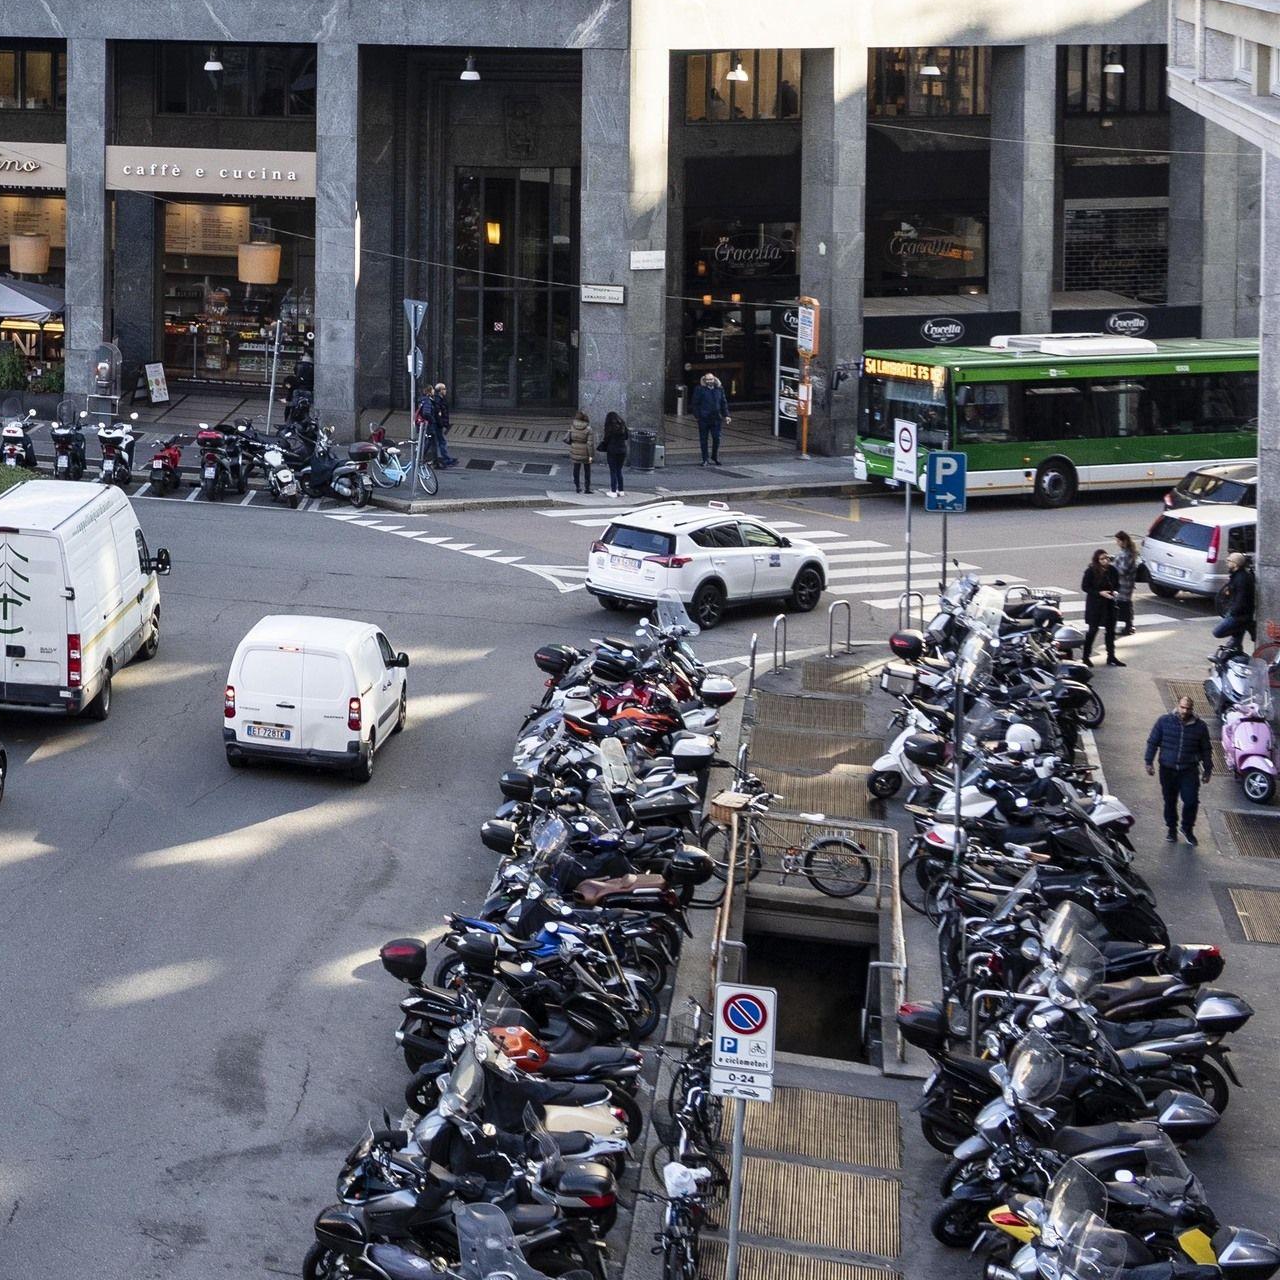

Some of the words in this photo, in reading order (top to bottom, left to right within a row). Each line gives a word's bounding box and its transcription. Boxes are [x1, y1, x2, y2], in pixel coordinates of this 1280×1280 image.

[123, 164, 181, 177] caffè
[196, 168, 205, 178] e
[220, 168, 297, 181] cucina
[936, 457, 958, 485] P
[723, 1039, 735, 1051] P
[725, 1056, 768, 1069] ciclomotori
[729, 1073, 754, 1083] 0-24
